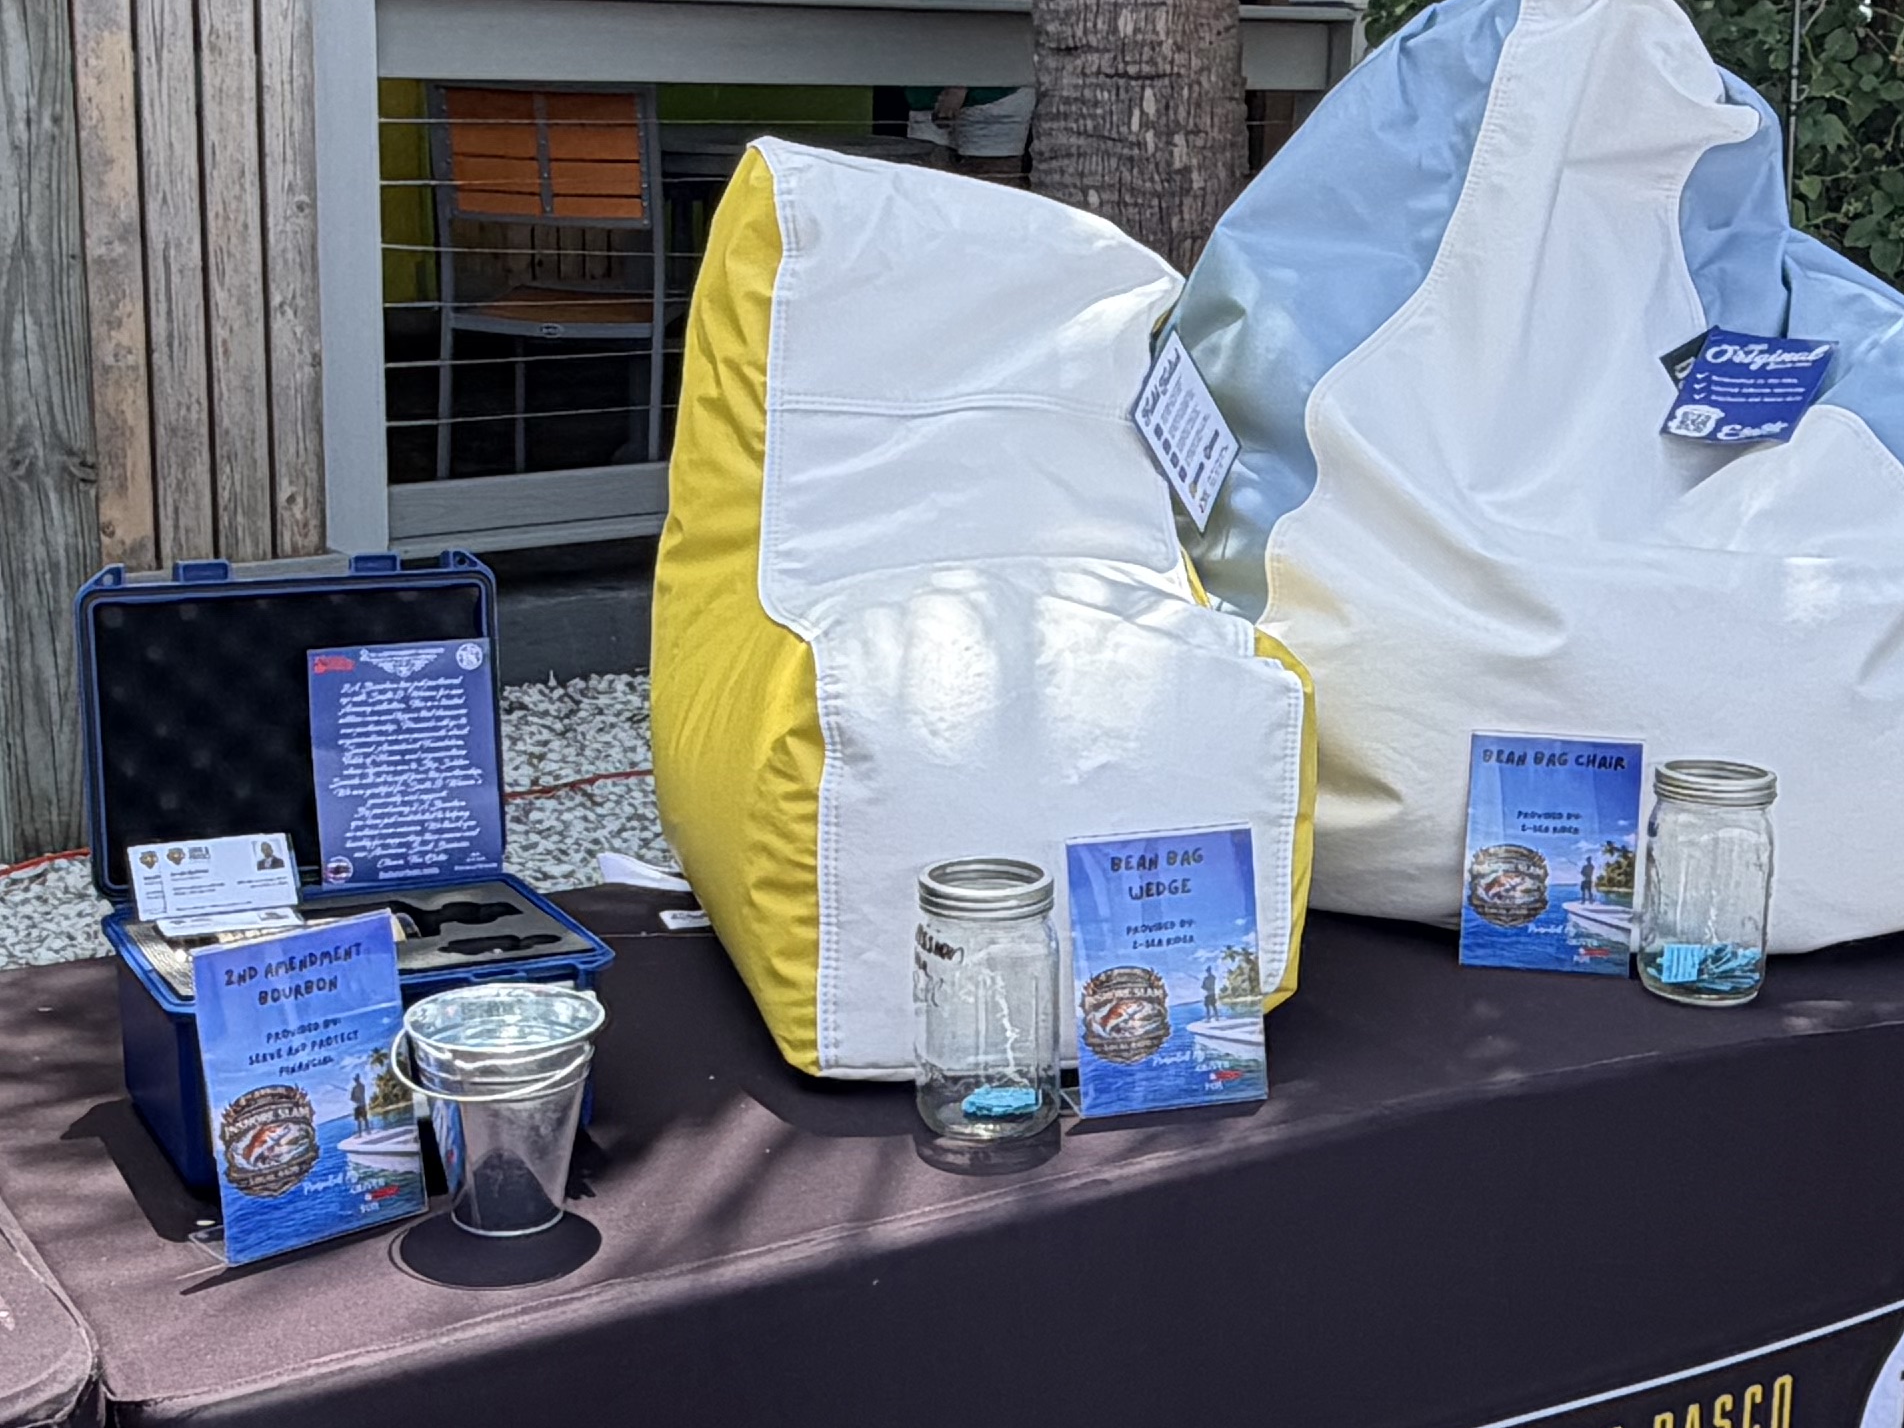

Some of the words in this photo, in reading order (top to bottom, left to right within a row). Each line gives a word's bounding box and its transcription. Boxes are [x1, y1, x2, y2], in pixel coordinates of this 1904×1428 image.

[1482, 748, 1528, 767] BEAN
[1532, 750, 1569, 767] BAG
[1574, 753, 1627, 772] CHAIR
[1110, 853, 1159, 873] BEAN
[1165, 847, 1204, 867] BAG
[1127, 877, 1192, 902] WEDGE
[224, 963, 259, 988] 2ND
[263, 941, 363, 979] AMENDMENT
[257, 974, 339, 1007] BOURBON
[310, 1029, 360, 1053] PROTECT
